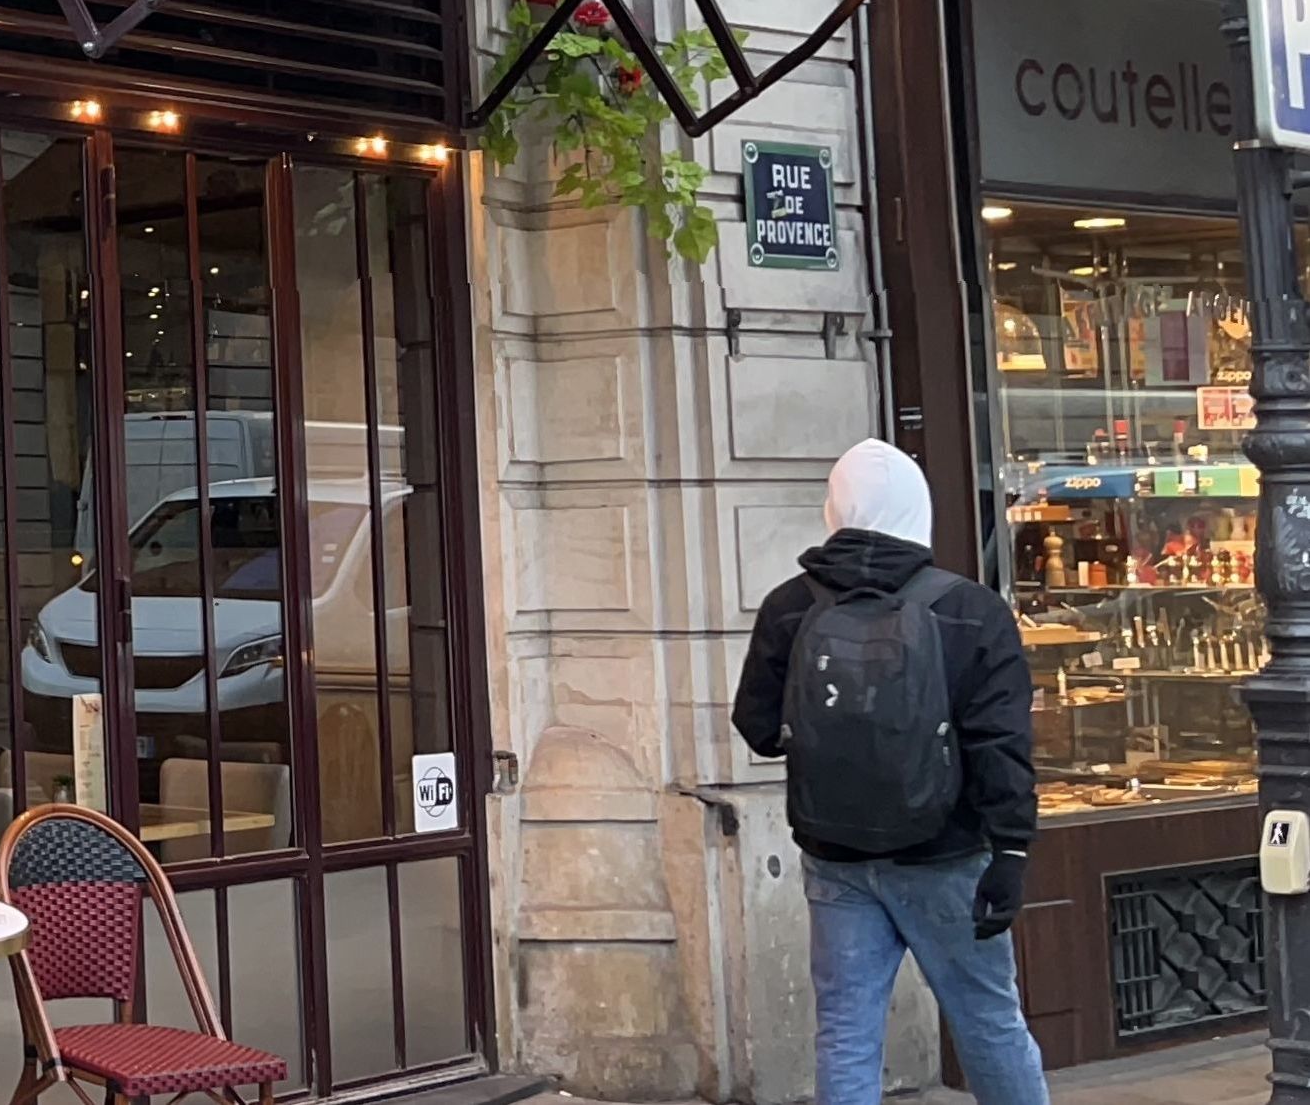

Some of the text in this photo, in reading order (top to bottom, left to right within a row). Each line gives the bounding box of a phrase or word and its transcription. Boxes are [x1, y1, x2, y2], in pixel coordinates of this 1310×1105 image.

[771, 163, 812, 189] RUE
[785, 196, 804, 215] DE
[756, 219, 832, 246] PROVENCE
